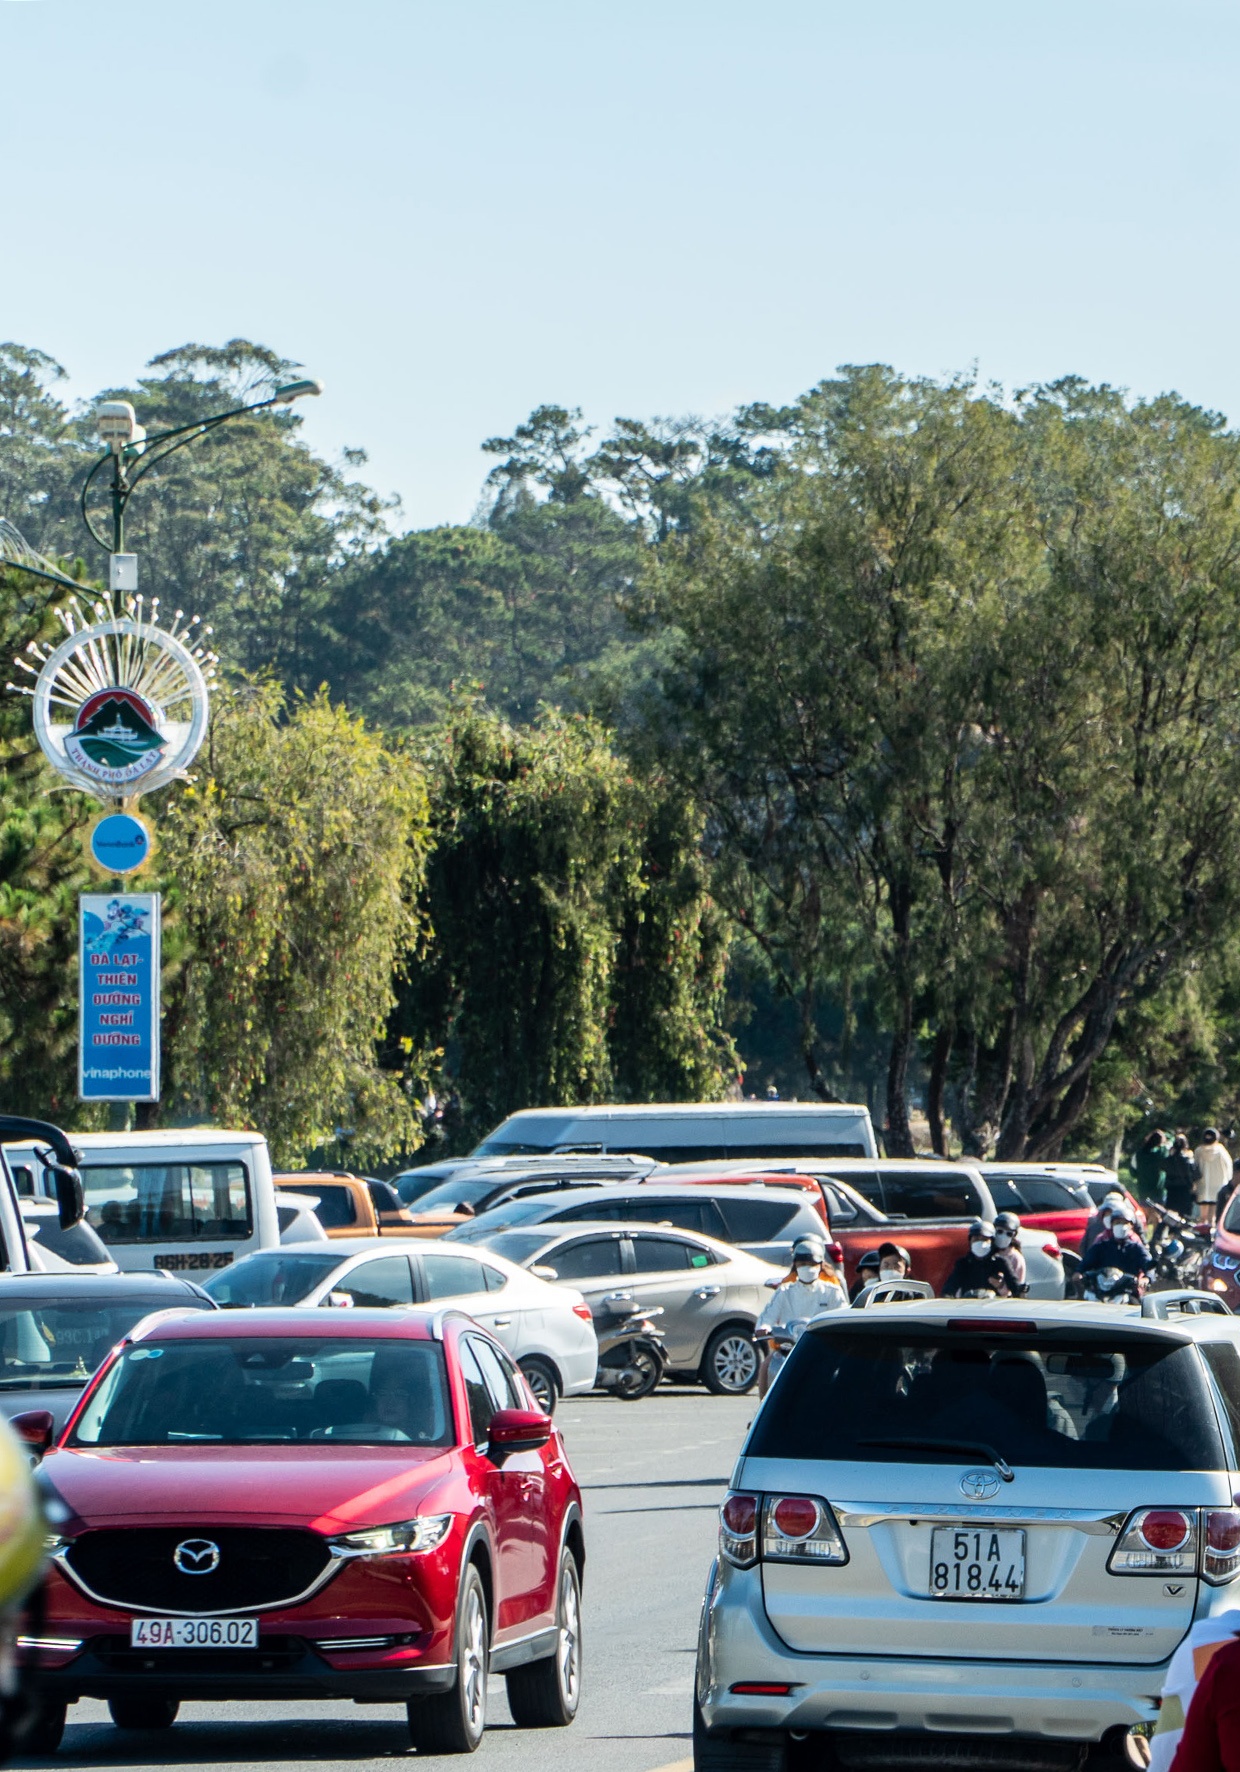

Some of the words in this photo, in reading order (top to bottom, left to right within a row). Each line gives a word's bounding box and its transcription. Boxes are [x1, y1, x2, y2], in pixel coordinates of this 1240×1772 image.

[90, 951, 110, 966] ĐÀ
[97, 971, 138, 986] THIÊN
[83, 1066, 151, 1080] vinaphone
[884, 1505, 1072, 1519] FORTUNER
[953, 1532, 1001, 1562] 51A
[934, 1562, 1019, 1593] 818.44
[136, 1621, 254, 1645] 49A-306.02
